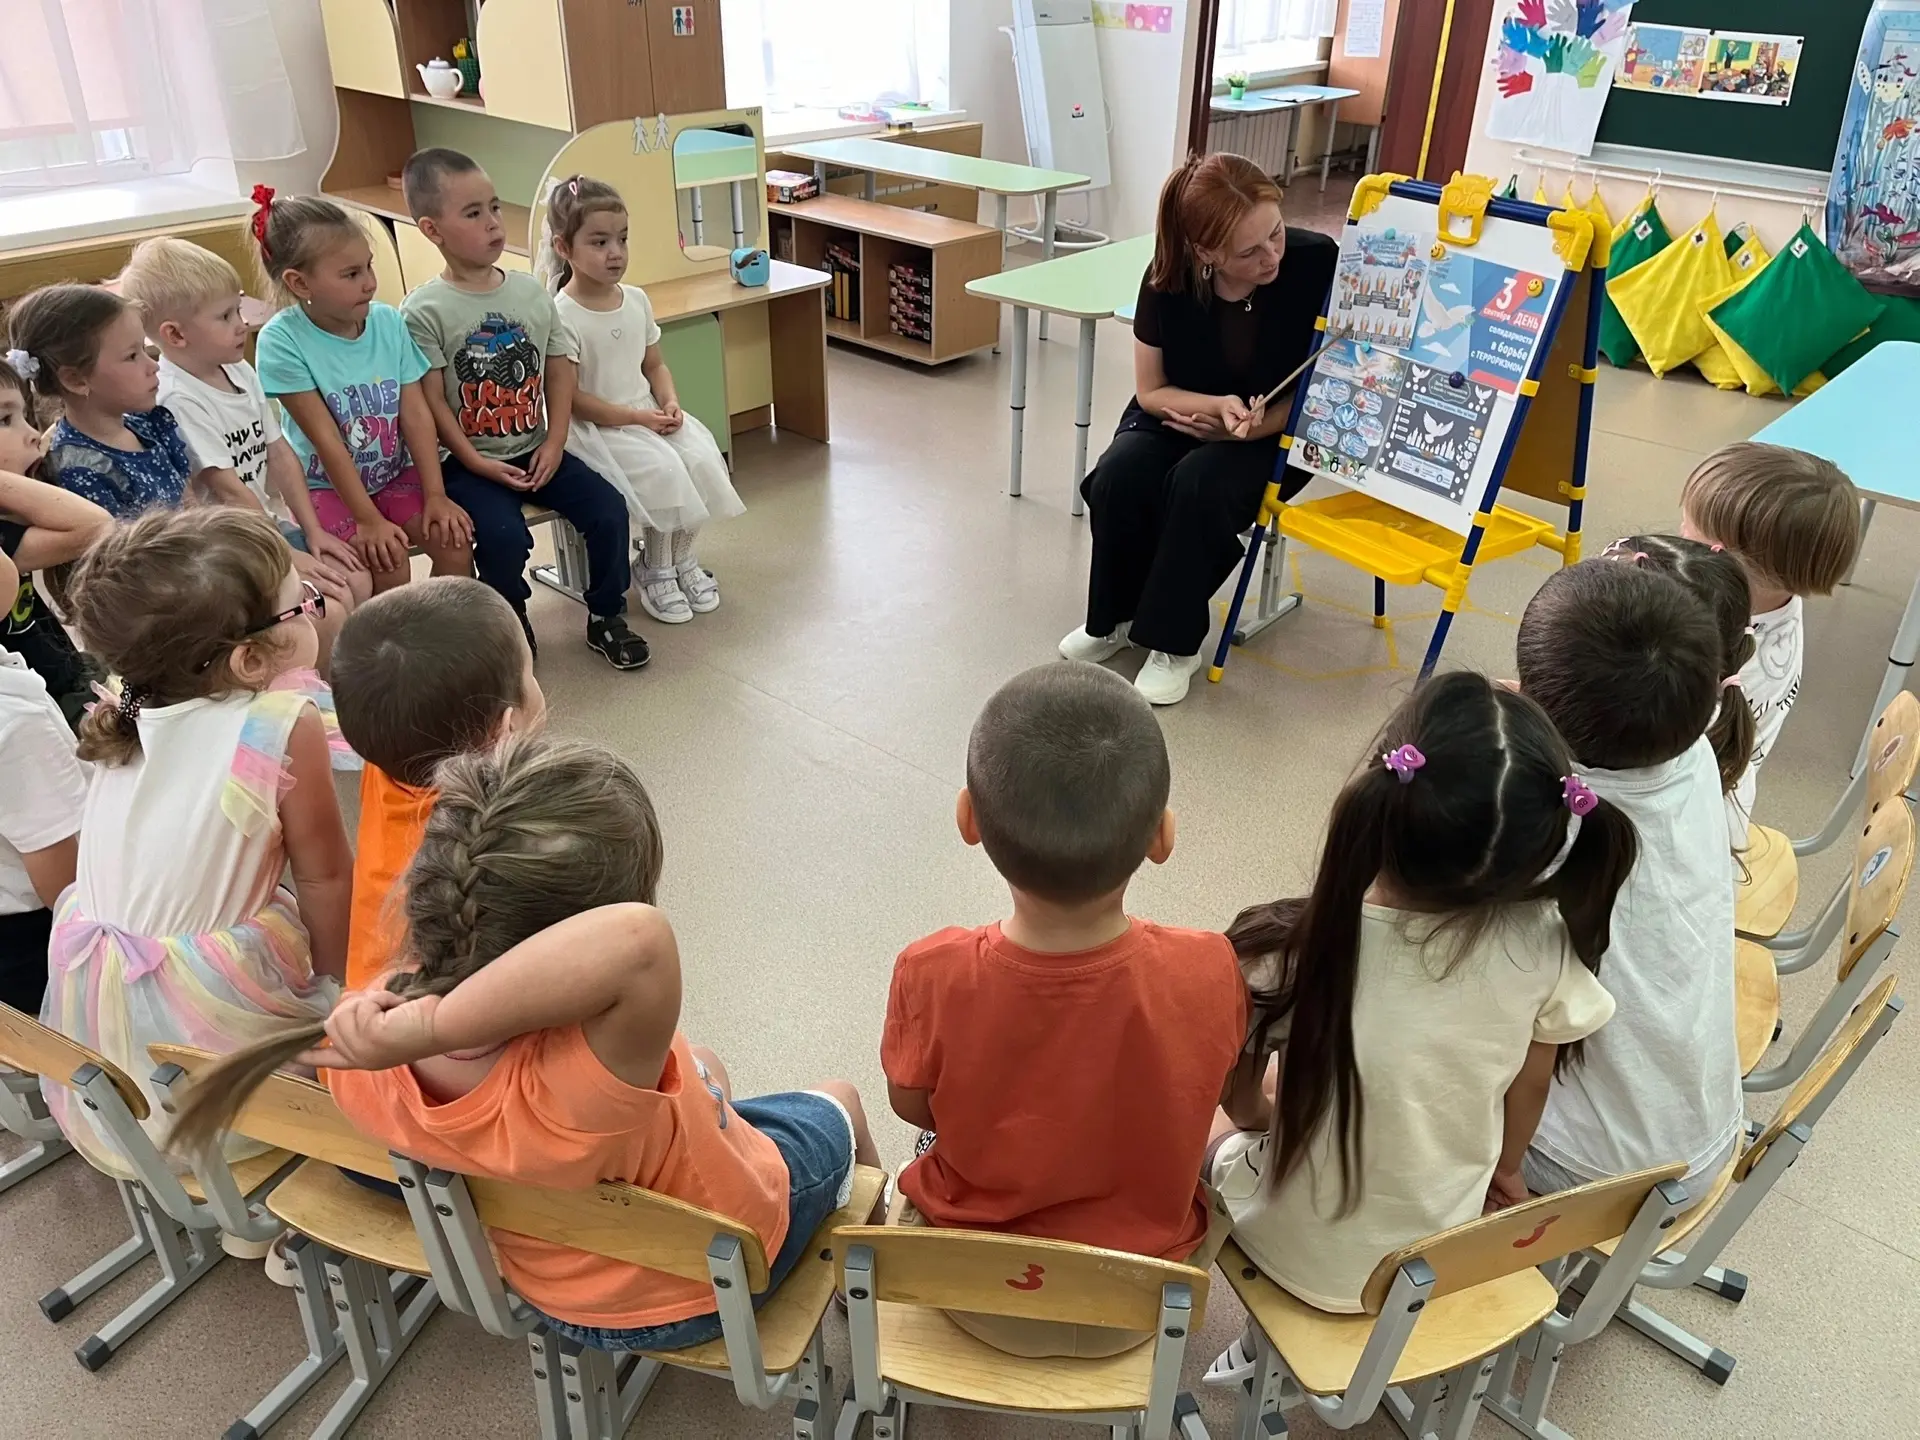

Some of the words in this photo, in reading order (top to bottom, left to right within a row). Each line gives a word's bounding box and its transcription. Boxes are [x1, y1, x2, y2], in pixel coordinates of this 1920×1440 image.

[1496, 277, 1517, 309] 3
[1483, 307, 1511, 322] сентября
[1513, 312, 1539, 330] ДЕНЬ
[1489, 325, 1533, 345] солидарности
[1476, 350, 1523, 374] ТЕРРОРИЗМОМ
[1490, 341, 1497, 351] в
[1498, 341, 1528, 361] борьбе
[327, 378, 399, 425] LIVE
[1005, 1263, 1046, 1291] 3
